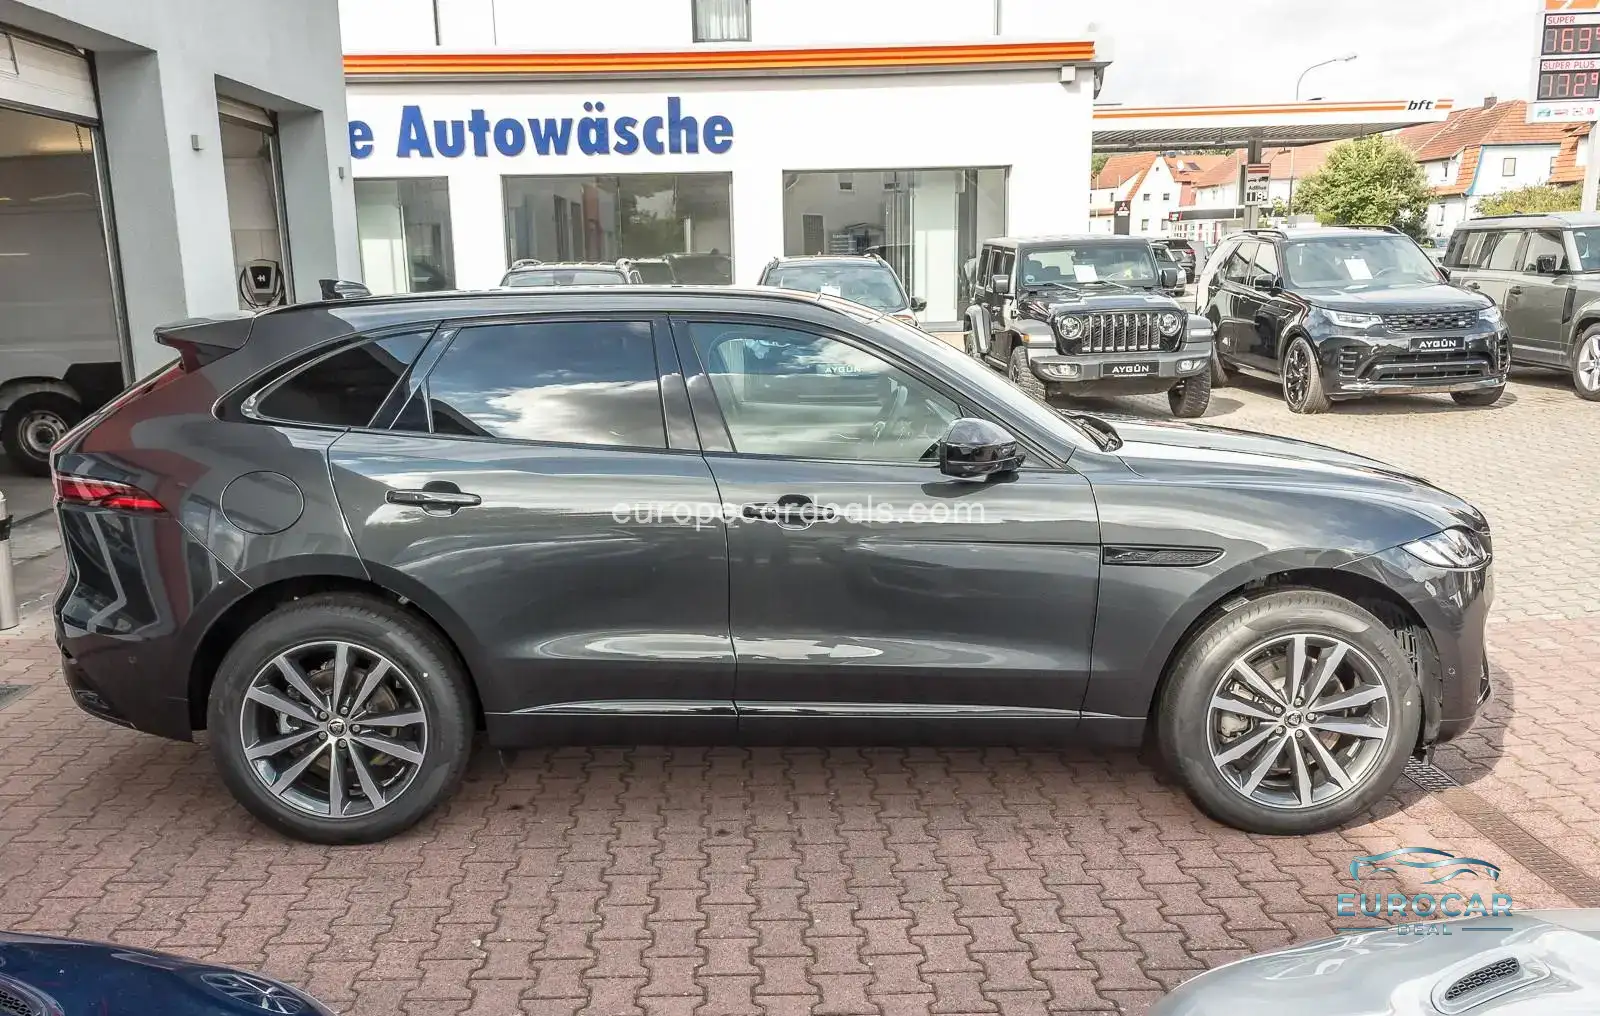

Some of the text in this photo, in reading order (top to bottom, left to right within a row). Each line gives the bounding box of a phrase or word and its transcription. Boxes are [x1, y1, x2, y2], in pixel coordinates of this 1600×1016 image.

[1547, 16, 1575, 24] SUPER
[1543, 61, 1571, 69] SUPER
[1408, 99, 1433, 110] bft
[396, 96, 734, 158] Autowäsche
[1112, 364, 1149, 373] AYGÜN
